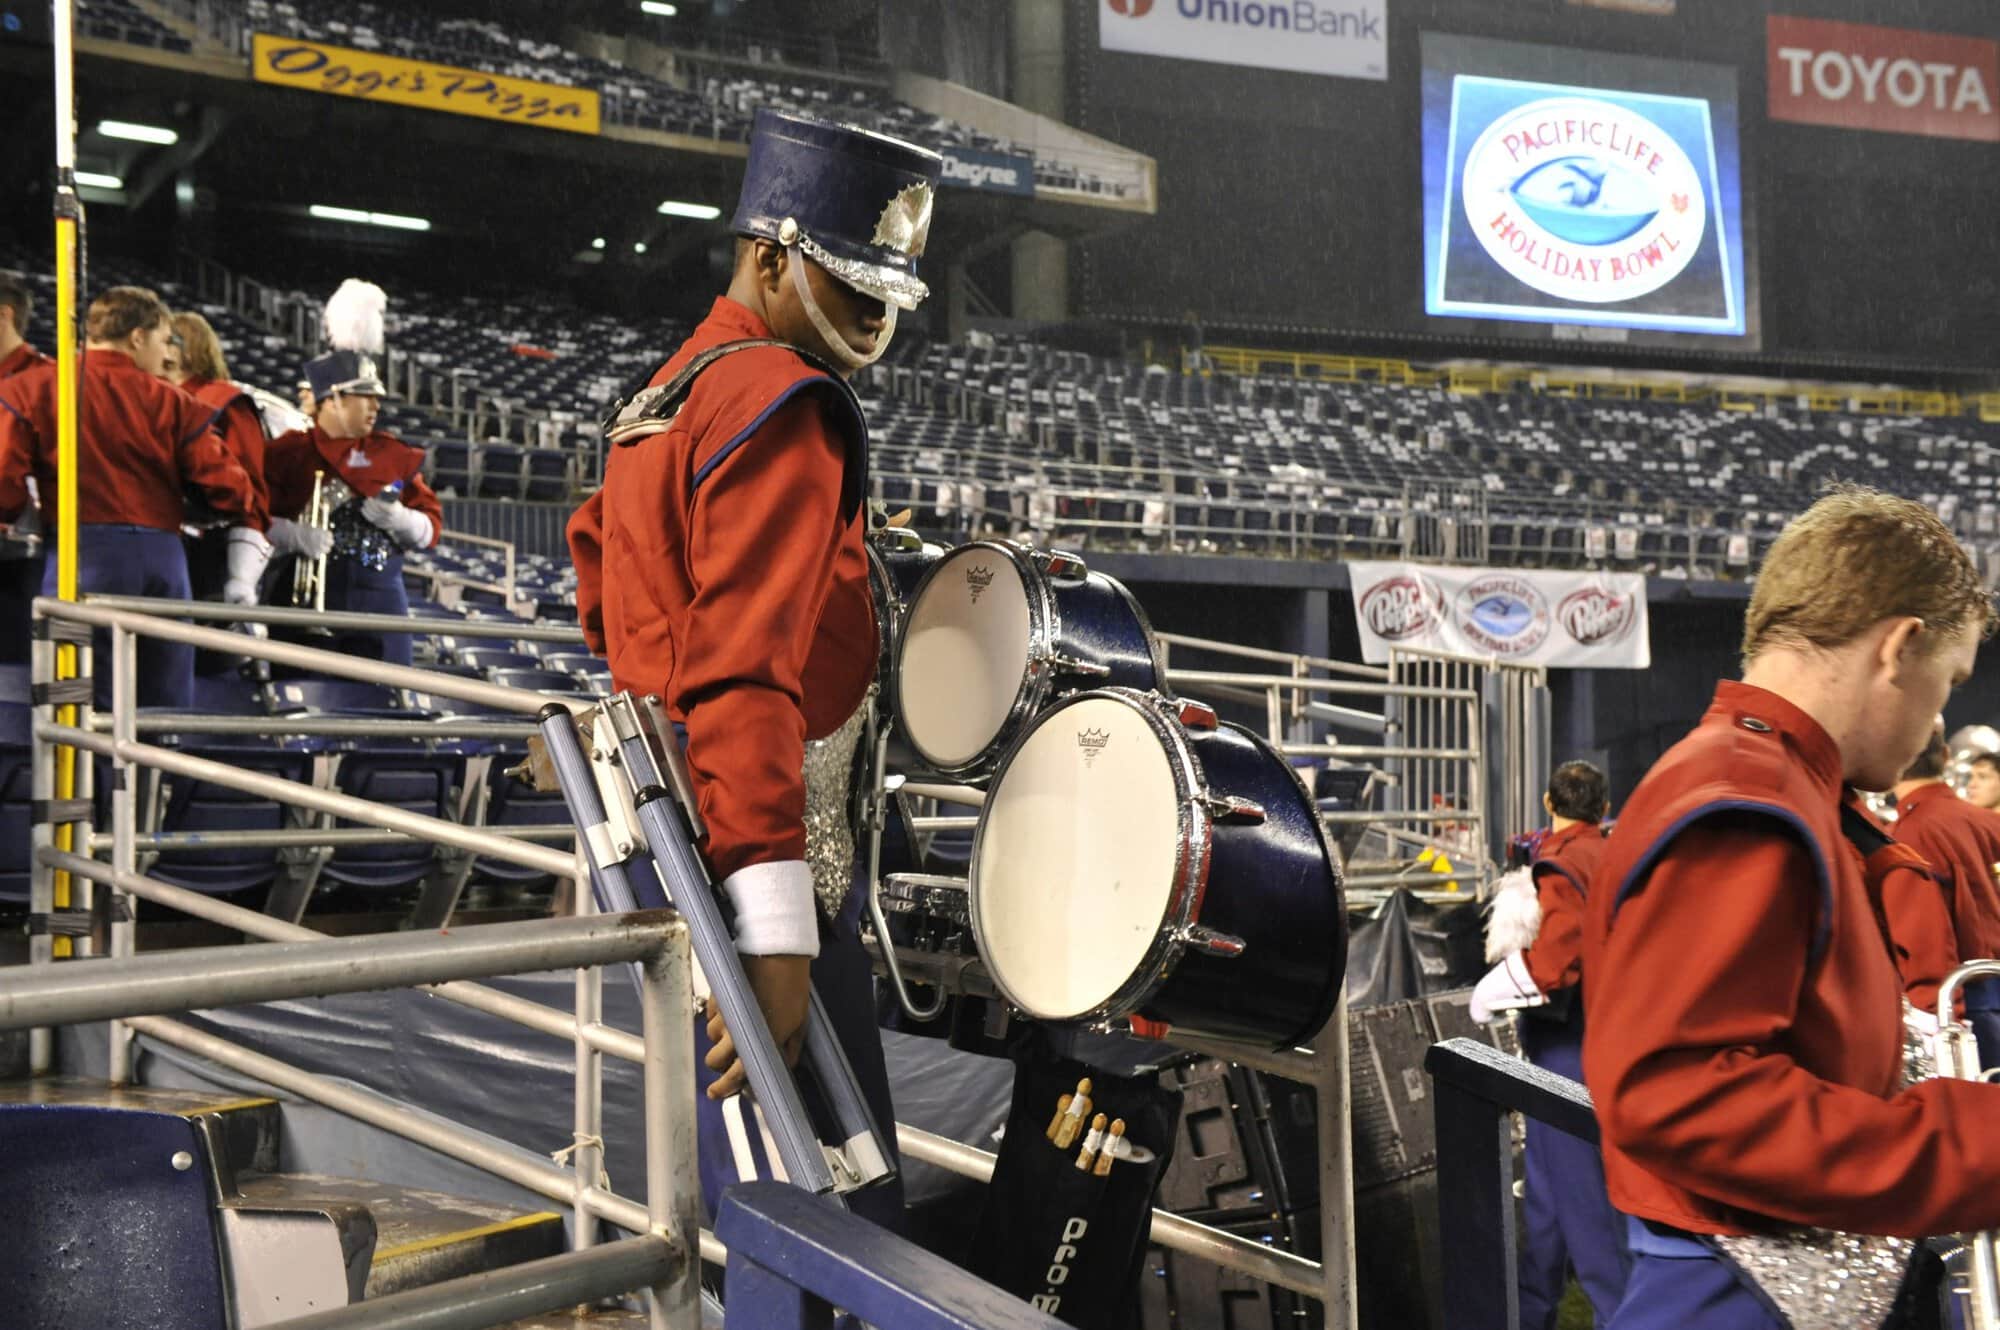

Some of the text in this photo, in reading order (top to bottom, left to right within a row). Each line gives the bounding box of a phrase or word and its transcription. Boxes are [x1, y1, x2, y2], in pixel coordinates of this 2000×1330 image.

[267, 46, 583, 118] Oggi's Pizza
[1778, 47, 1992, 115] TOYOTA
[942, 155, 1017, 187] Degree
[1490, 212, 1681, 282] HOLIDAY BOWL
[1080, 736, 1107, 746] REMO
